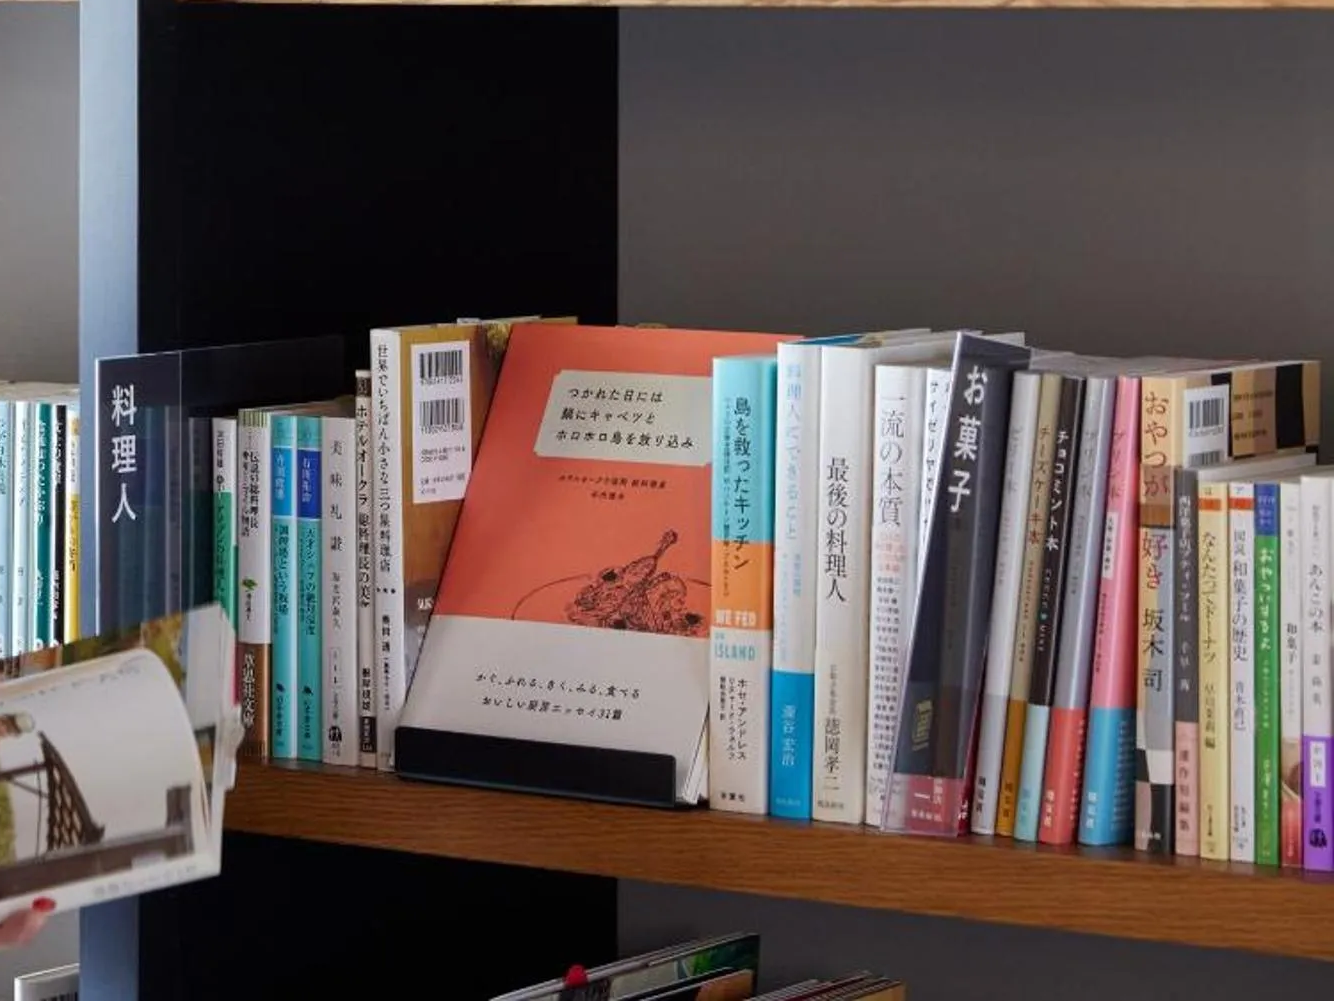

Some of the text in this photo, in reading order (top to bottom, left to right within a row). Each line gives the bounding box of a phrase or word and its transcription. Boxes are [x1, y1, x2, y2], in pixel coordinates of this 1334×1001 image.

[111, 384, 138, 523] 料理人
[560, 407, 656, 425] 鍋にキャベツと
[568, 387, 664, 403] つかれた日には
[947, 365, 988, 513] お菓子
[377, 344, 392, 573] 世界でいちばん小さな三つ星料理店
[733, 395, 752, 571] 島を救ったキッチン
[878, 394, 905, 528] 一流の本質
[1029, 425, 1051, 546] チーズケーキ本
[1044, 429, 1070, 554] チョコミント本
[823, 456, 849, 602] 最後の料理人
[714, 643, 756, 660] ISLAND
[1140, 607, 1165, 693] 坂木司
[1201, 531, 1217, 664] なんたってドーナツ
[1232, 561, 1249, 662] 和菓子の歴史
[1309, 564, 1324, 634] あんこの本
[737, 678, 748, 761] ホセ・アンドレス
